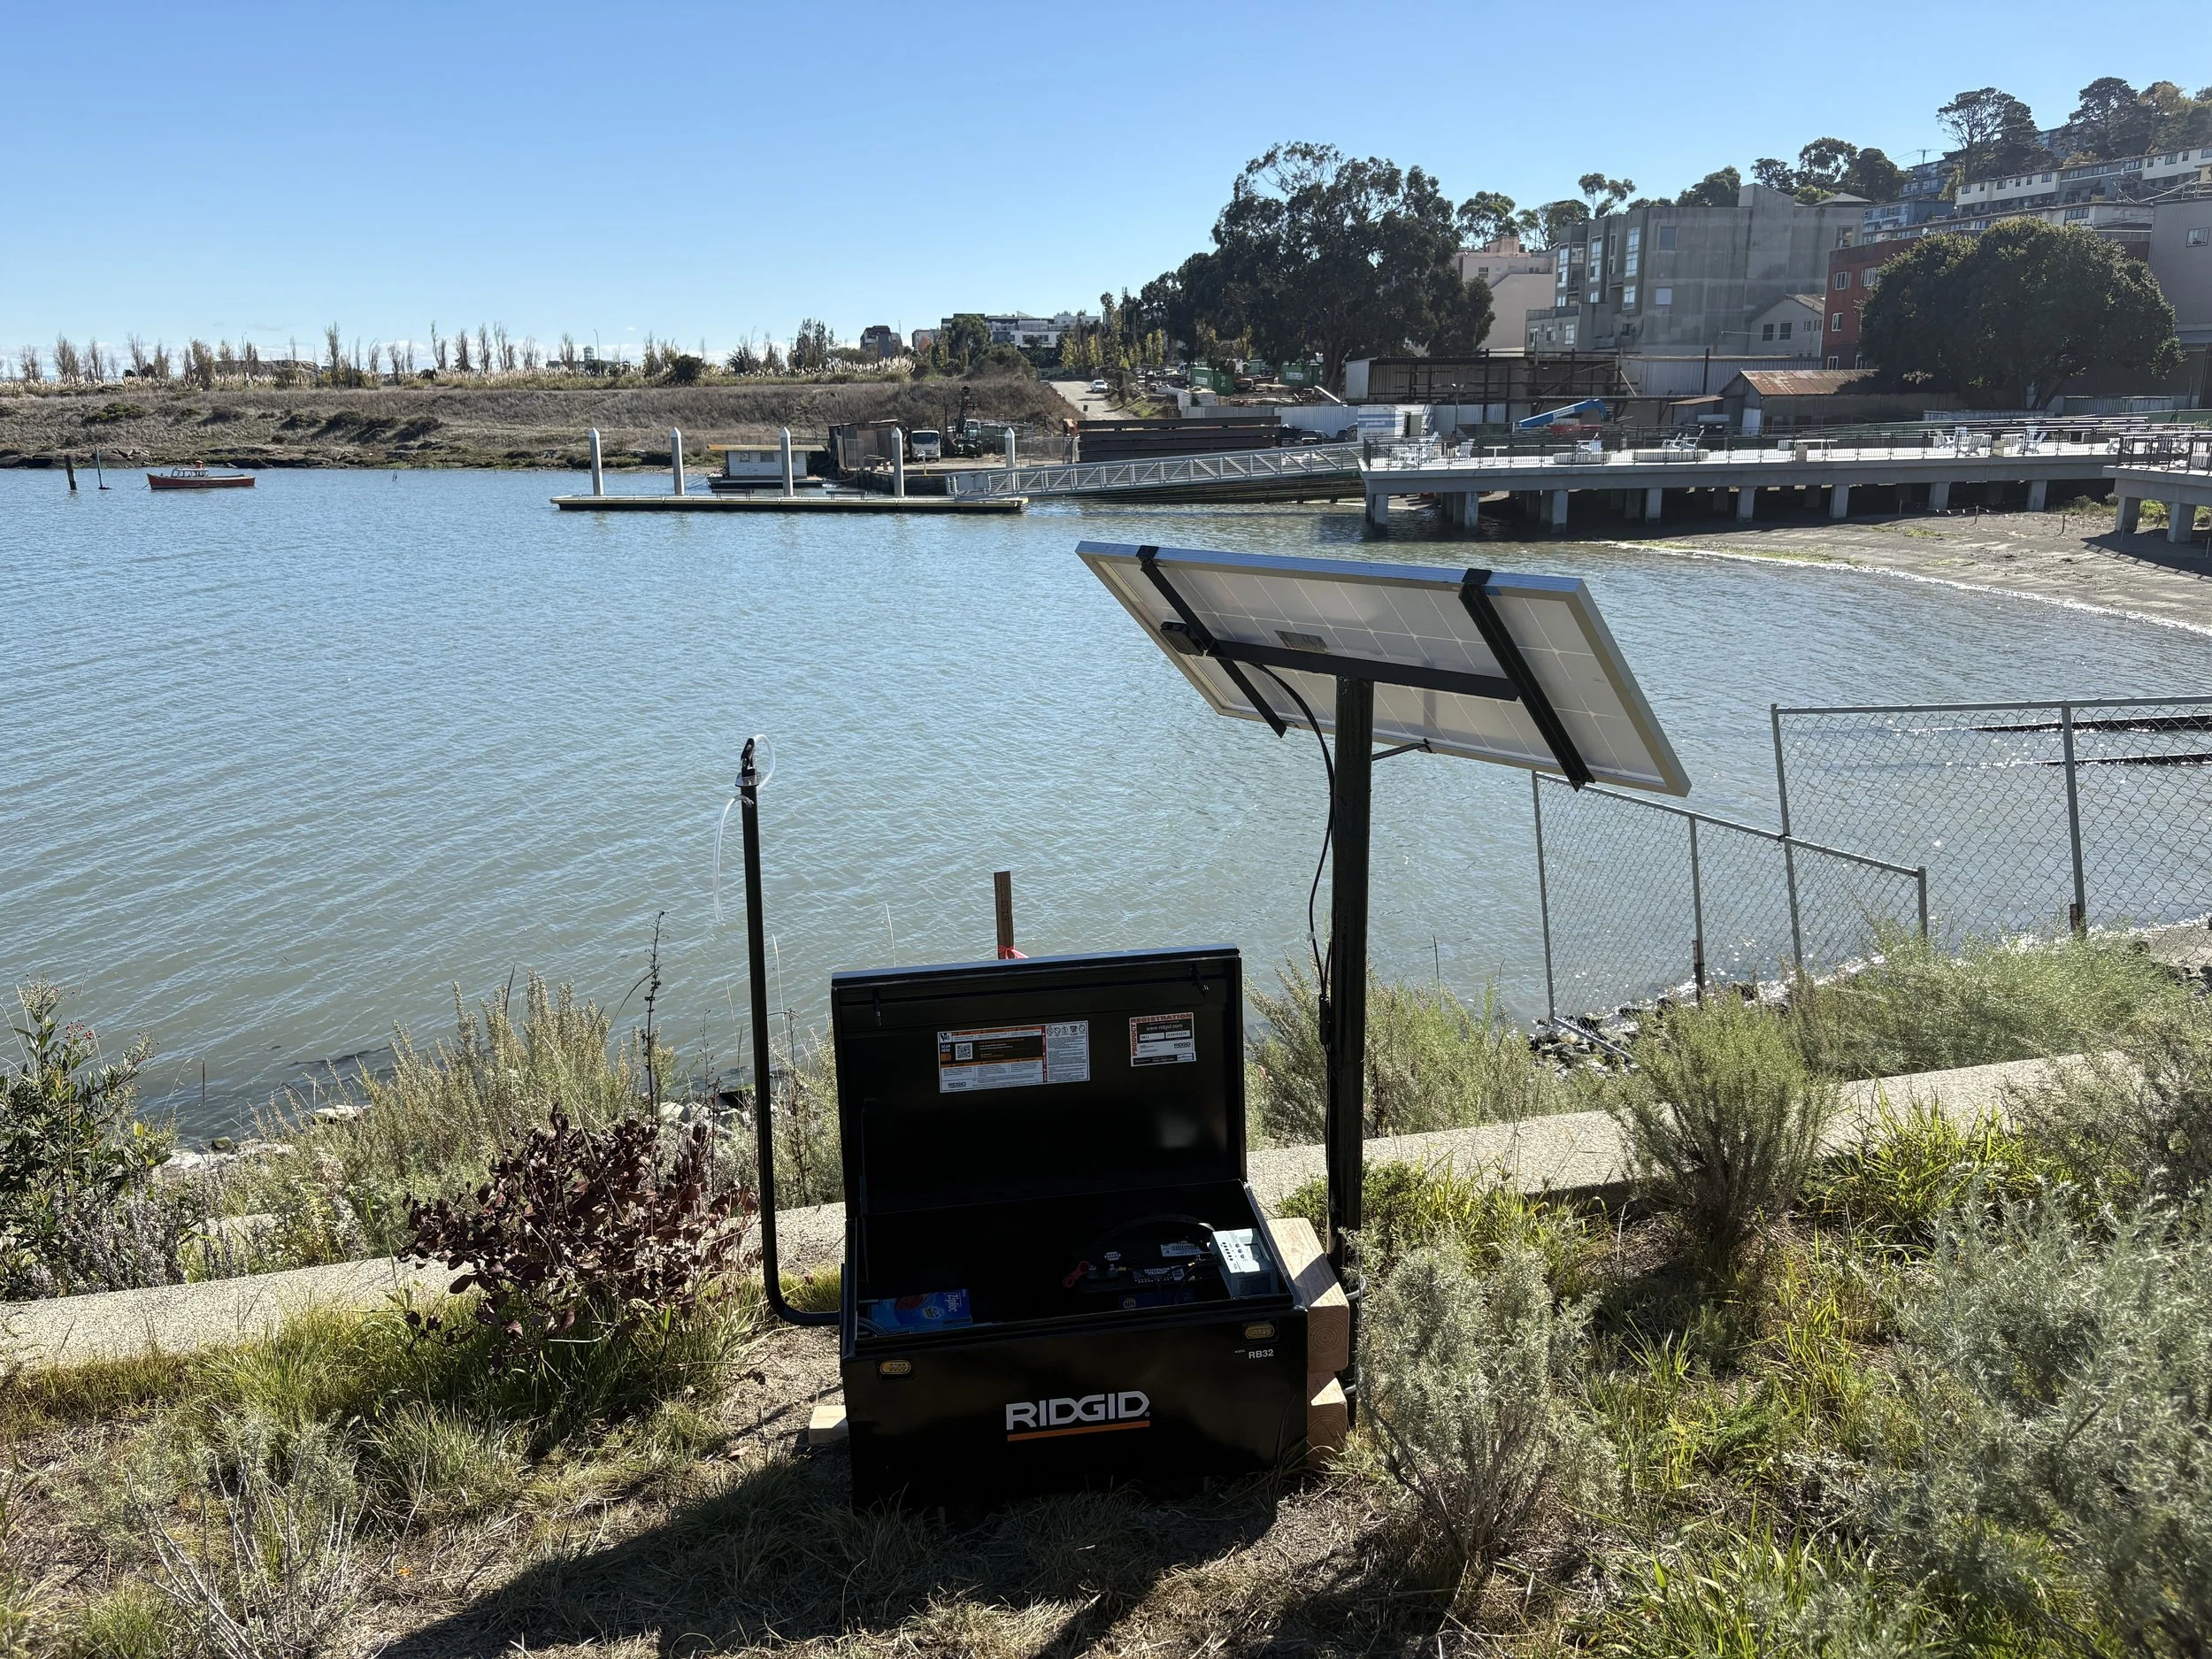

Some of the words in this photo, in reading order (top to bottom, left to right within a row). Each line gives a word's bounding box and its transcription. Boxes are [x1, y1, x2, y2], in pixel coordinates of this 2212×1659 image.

[1131, 1013, 1192, 1023] REGISTRATION
[944, 1293, 960, 1313] Ziploc
[1248, 1348, 1274, 1359] RB32
[1005, 1390, 1150, 1431] RIDGID
